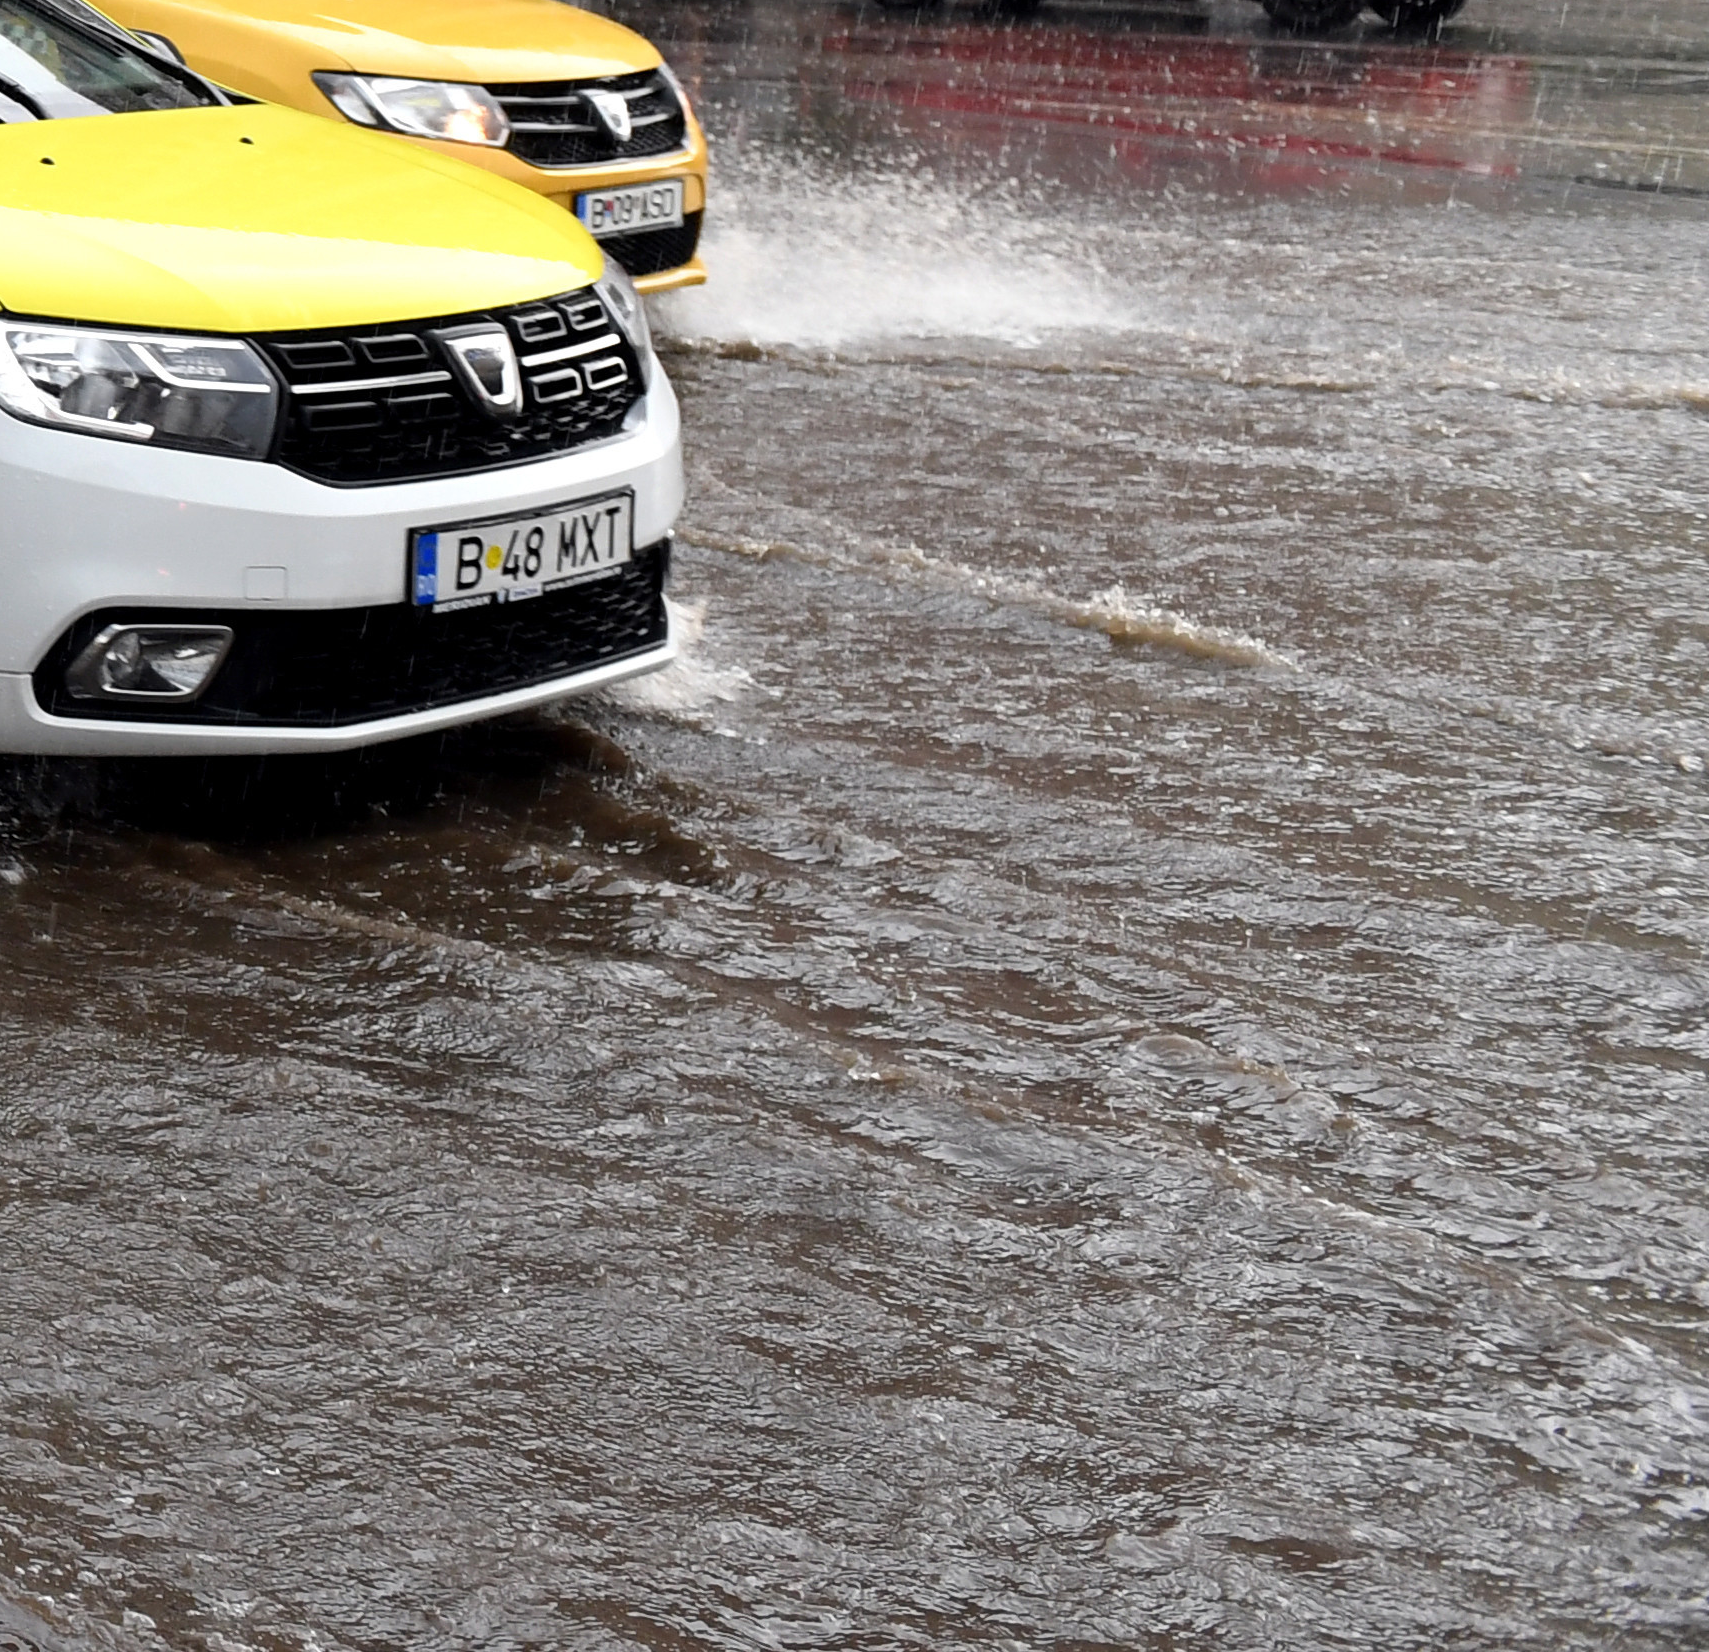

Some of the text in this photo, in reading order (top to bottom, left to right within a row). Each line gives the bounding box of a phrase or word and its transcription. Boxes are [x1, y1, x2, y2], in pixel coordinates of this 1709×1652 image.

[592, 198, 606, 228] B
[456, 535, 484, 592] B
[500, 525, 545, 582] 48
[555, 505, 622, 573] MXT
